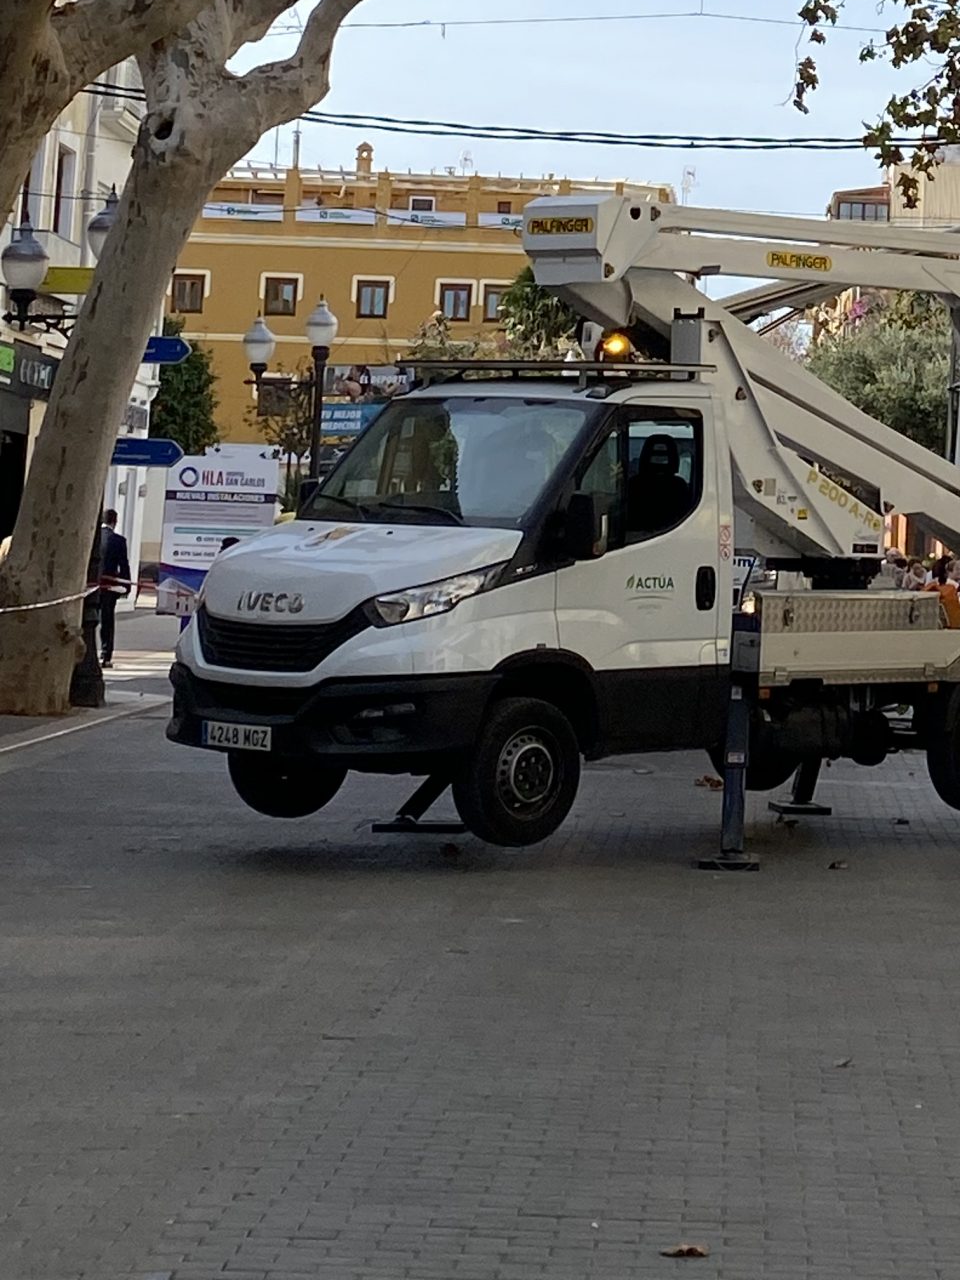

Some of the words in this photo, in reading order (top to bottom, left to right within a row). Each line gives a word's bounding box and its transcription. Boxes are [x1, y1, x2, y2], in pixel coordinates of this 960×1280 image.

[531, 220, 589, 234] PALFINGER
[771, 253, 828, 271] PALFINGER
[202, 470, 224, 486] HLA
[225, 477, 238, 486] SAN
[240, 478, 265, 488] CARLOS
[807, 469, 818, 484] P
[819, 481, 849, 508] 200
[176, 492, 205, 500] NUEVAS
[207, 493, 265, 502] INSTALACIONES
[636, 574, 674, 589] ACTÚA
[237, 592, 304, 613] IVECO
[209, 725, 239, 745] 4248
[243, 727, 268, 748] MGZ
